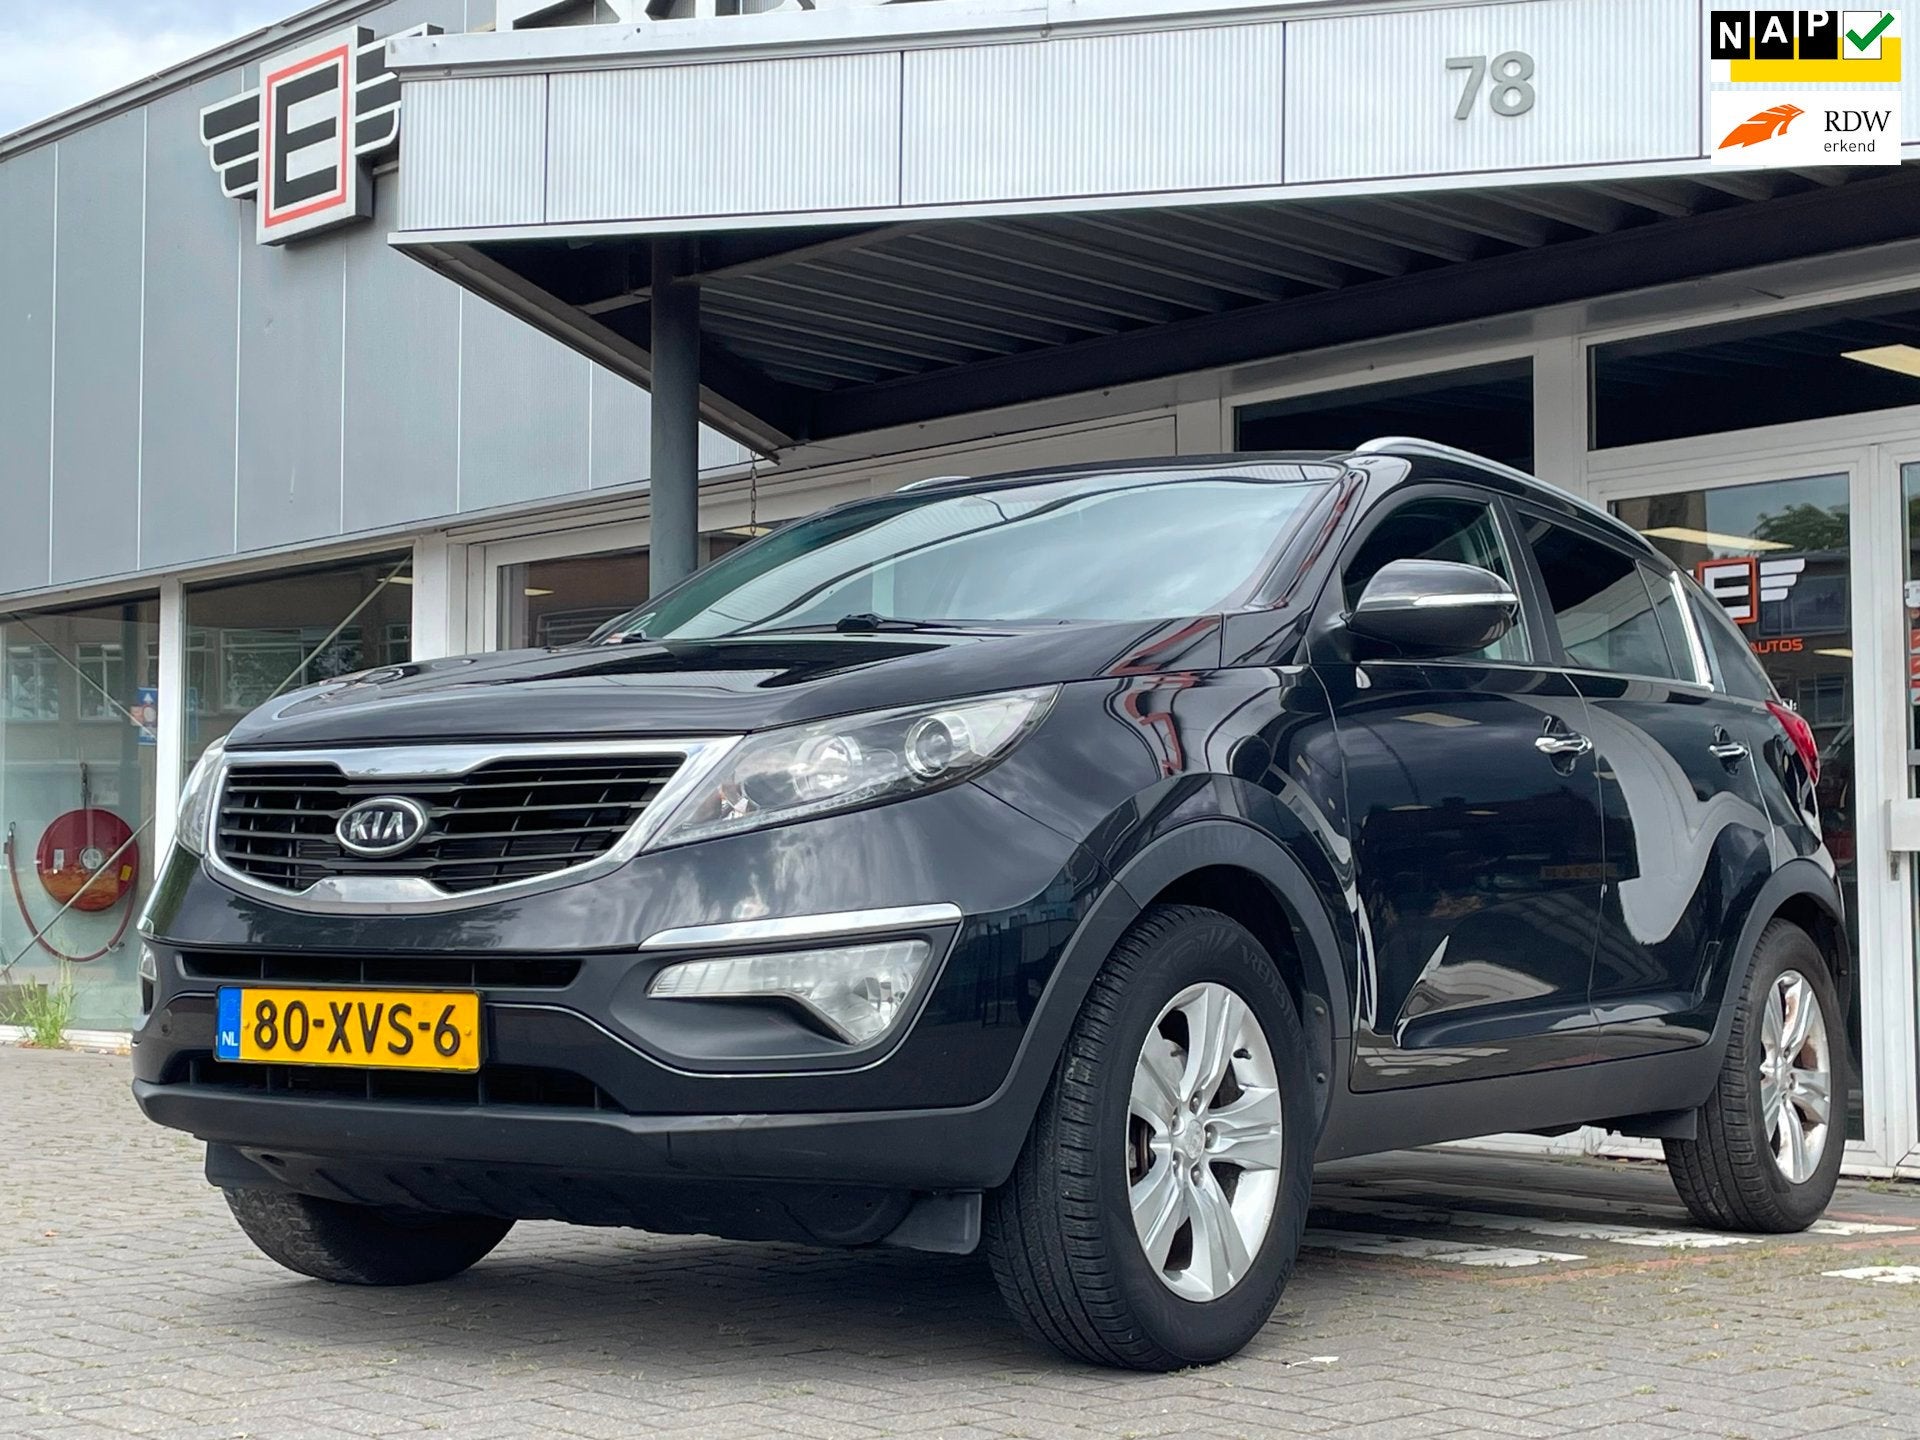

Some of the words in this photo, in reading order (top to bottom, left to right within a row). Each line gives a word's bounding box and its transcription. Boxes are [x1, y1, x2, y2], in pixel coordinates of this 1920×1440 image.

[1445, 51, 1535, 121] 78
[1749, 639, 1803, 654] AUTOS
[349, 811, 405, 841] KIA
[221, 1031, 239, 1047] NL
[253, 999, 461, 1057] 80-XVS-6
